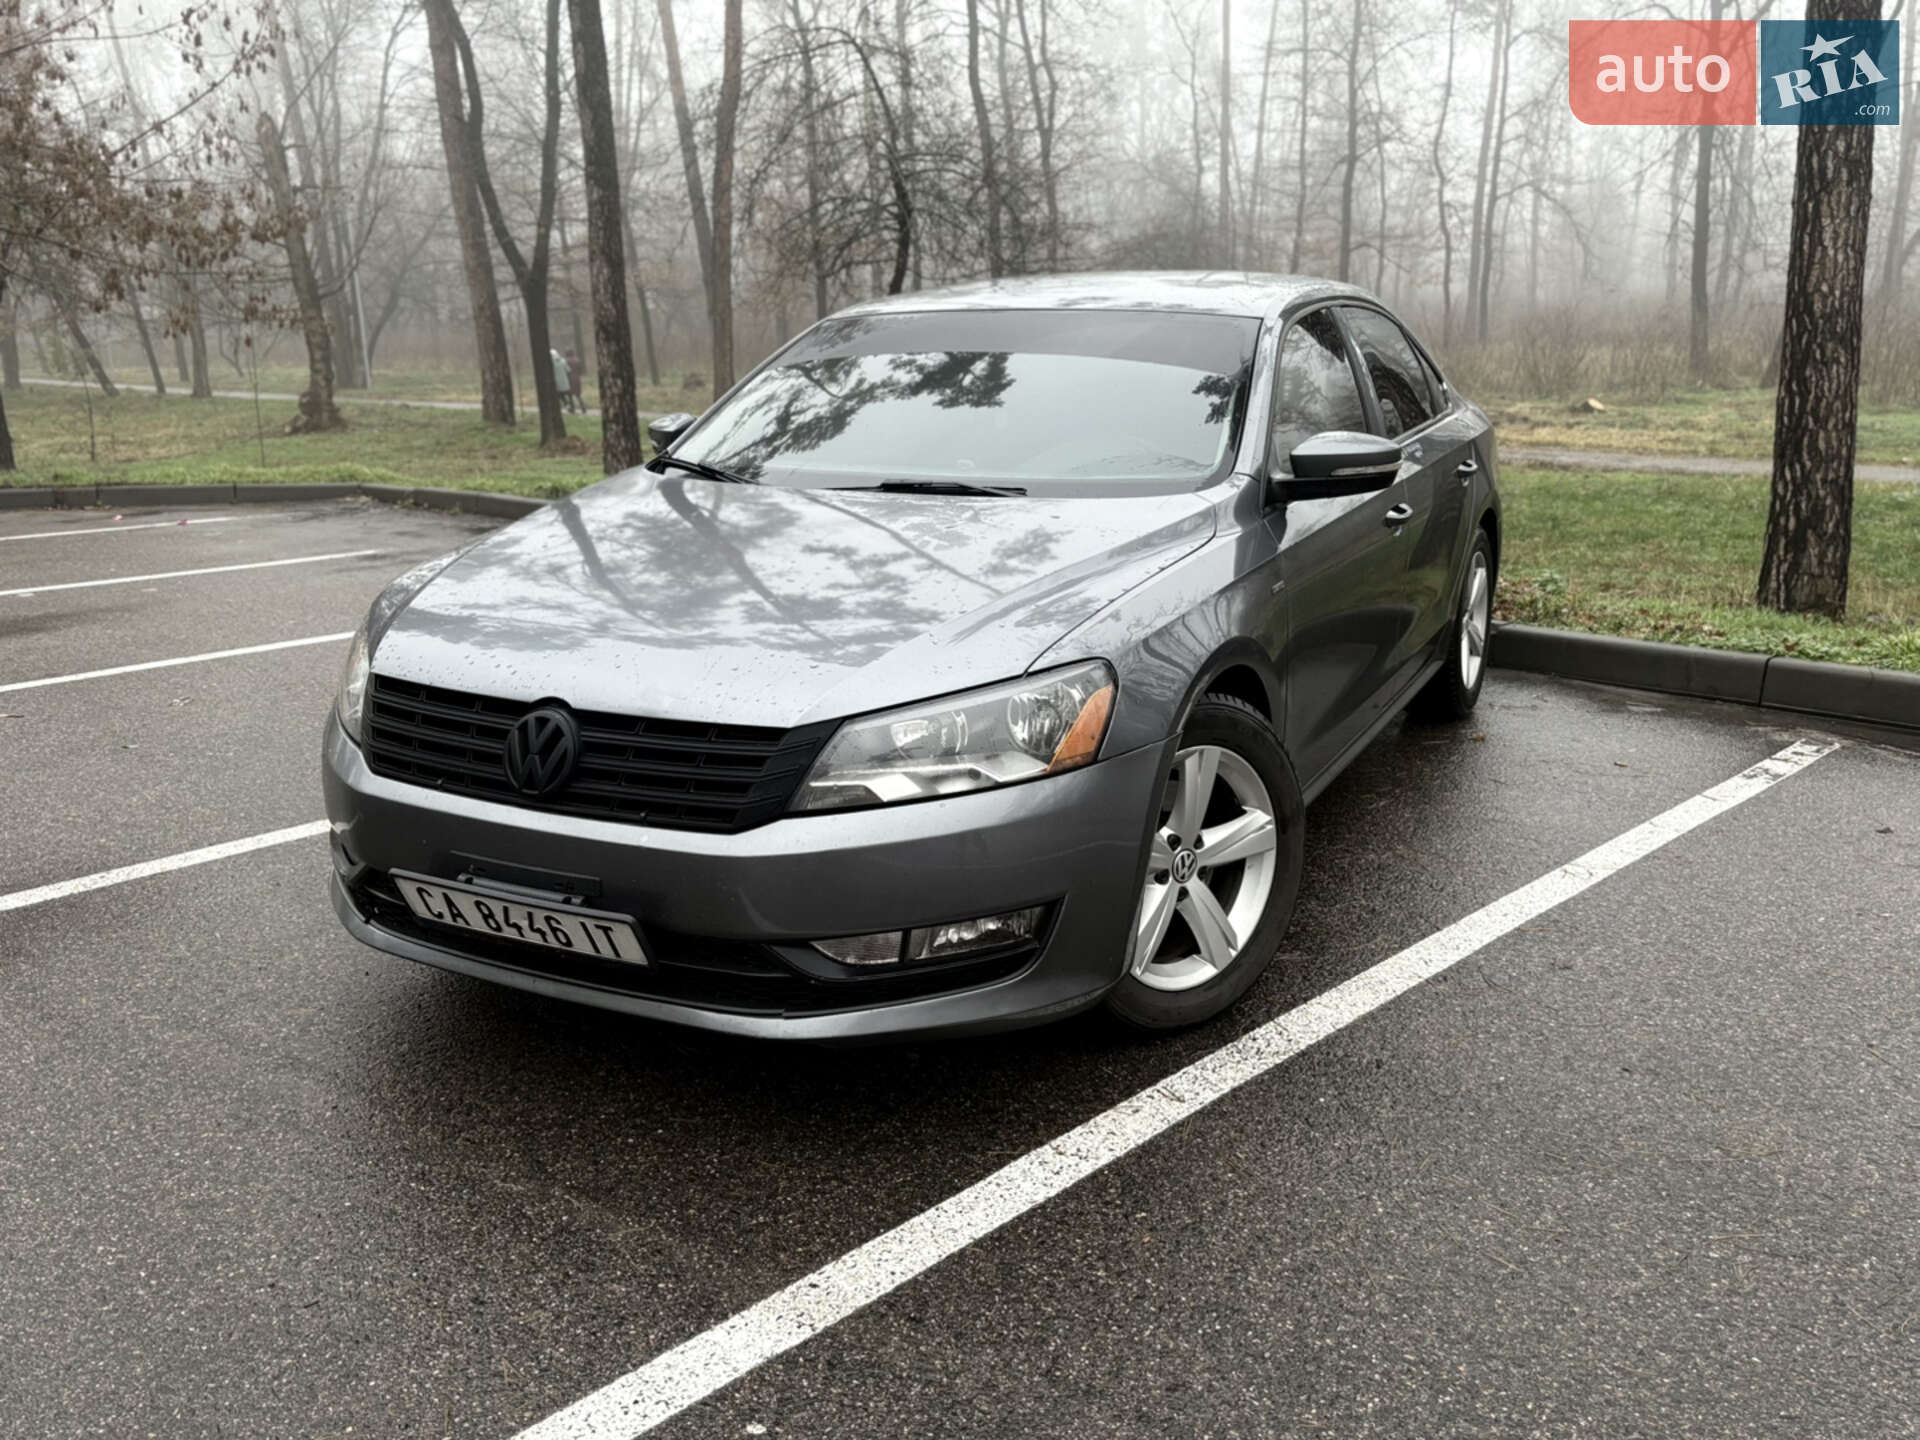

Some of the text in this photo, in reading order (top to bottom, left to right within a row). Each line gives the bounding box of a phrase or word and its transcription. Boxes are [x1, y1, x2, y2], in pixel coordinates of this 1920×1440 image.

[505, 708, 577, 794] VW
[415, 886, 622, 958] CA 8446 IT
